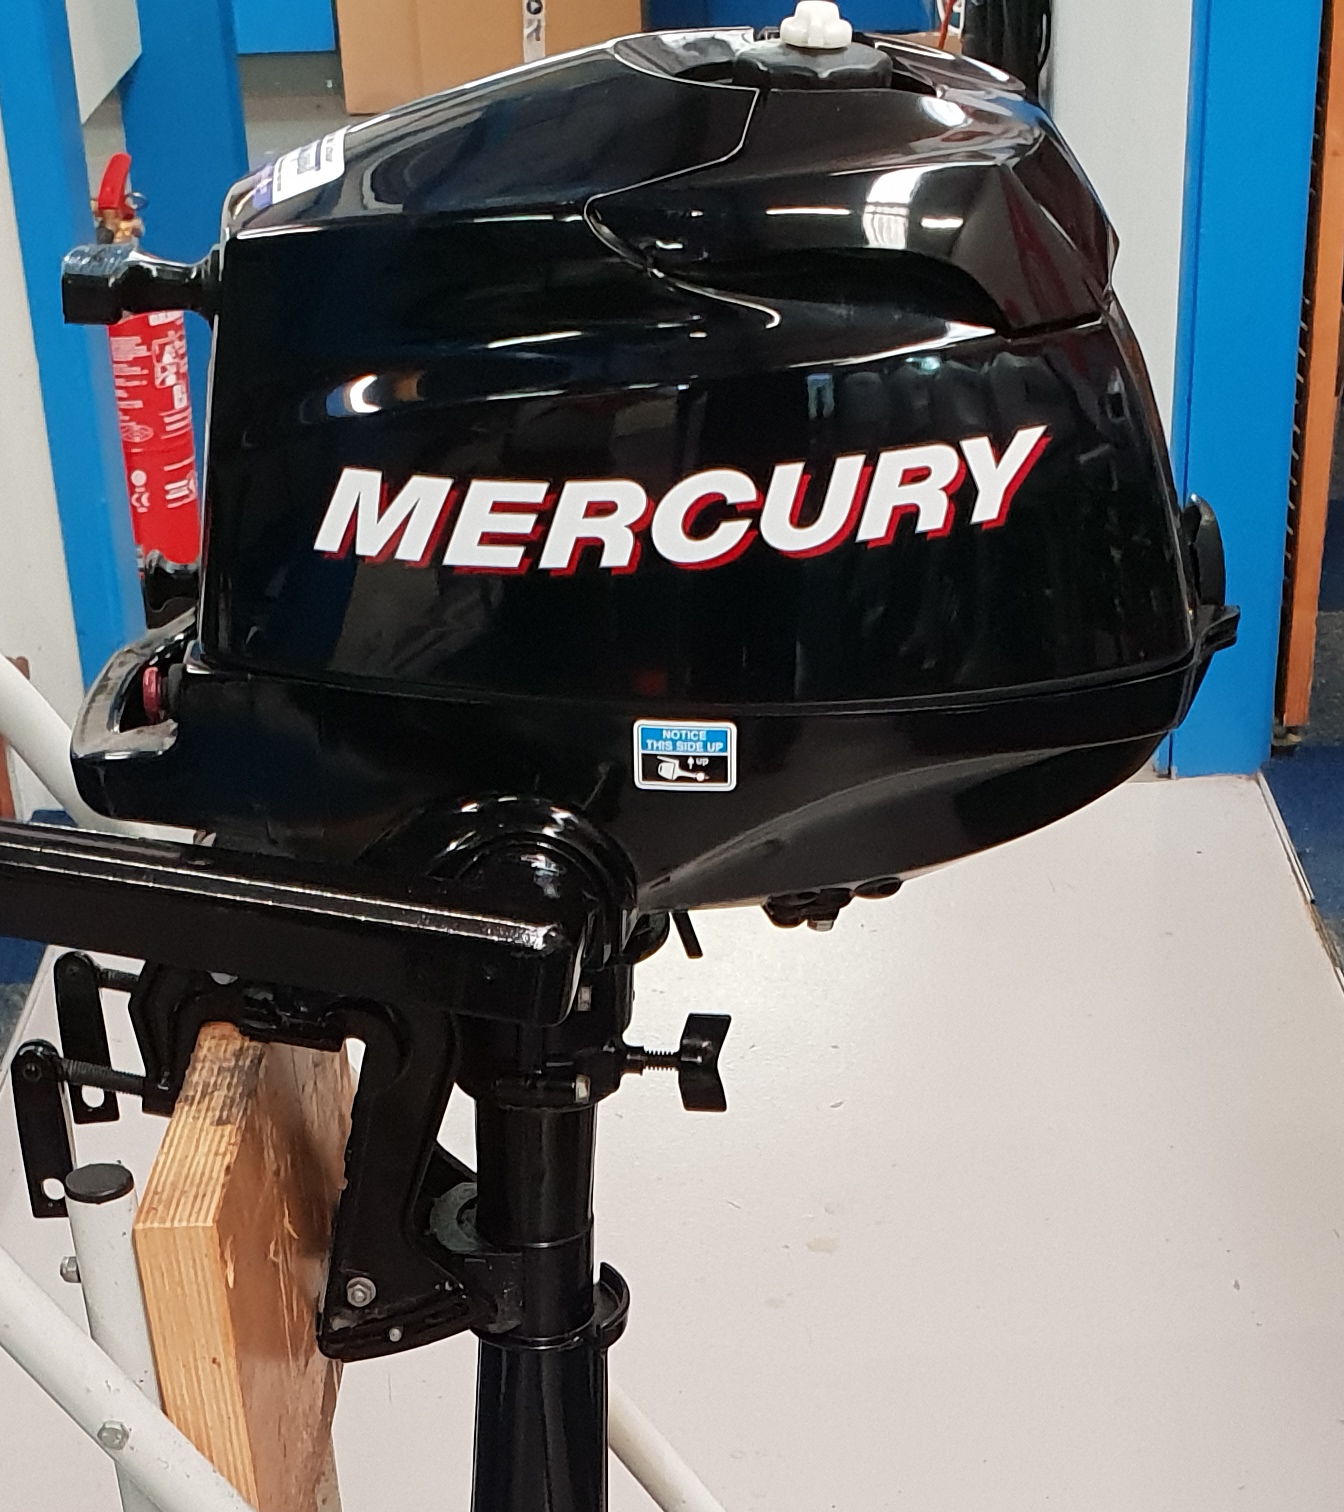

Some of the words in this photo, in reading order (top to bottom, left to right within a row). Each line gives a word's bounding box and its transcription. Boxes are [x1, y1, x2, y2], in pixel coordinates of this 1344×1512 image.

[313, 424, 1051, 576] MERCURY
[662, 729, 707, 741] NOTICE
[646, 739, 673, 751] THIS
[676, 740, 704, 752] SIDE
[707, 742, 724, 753] UP
